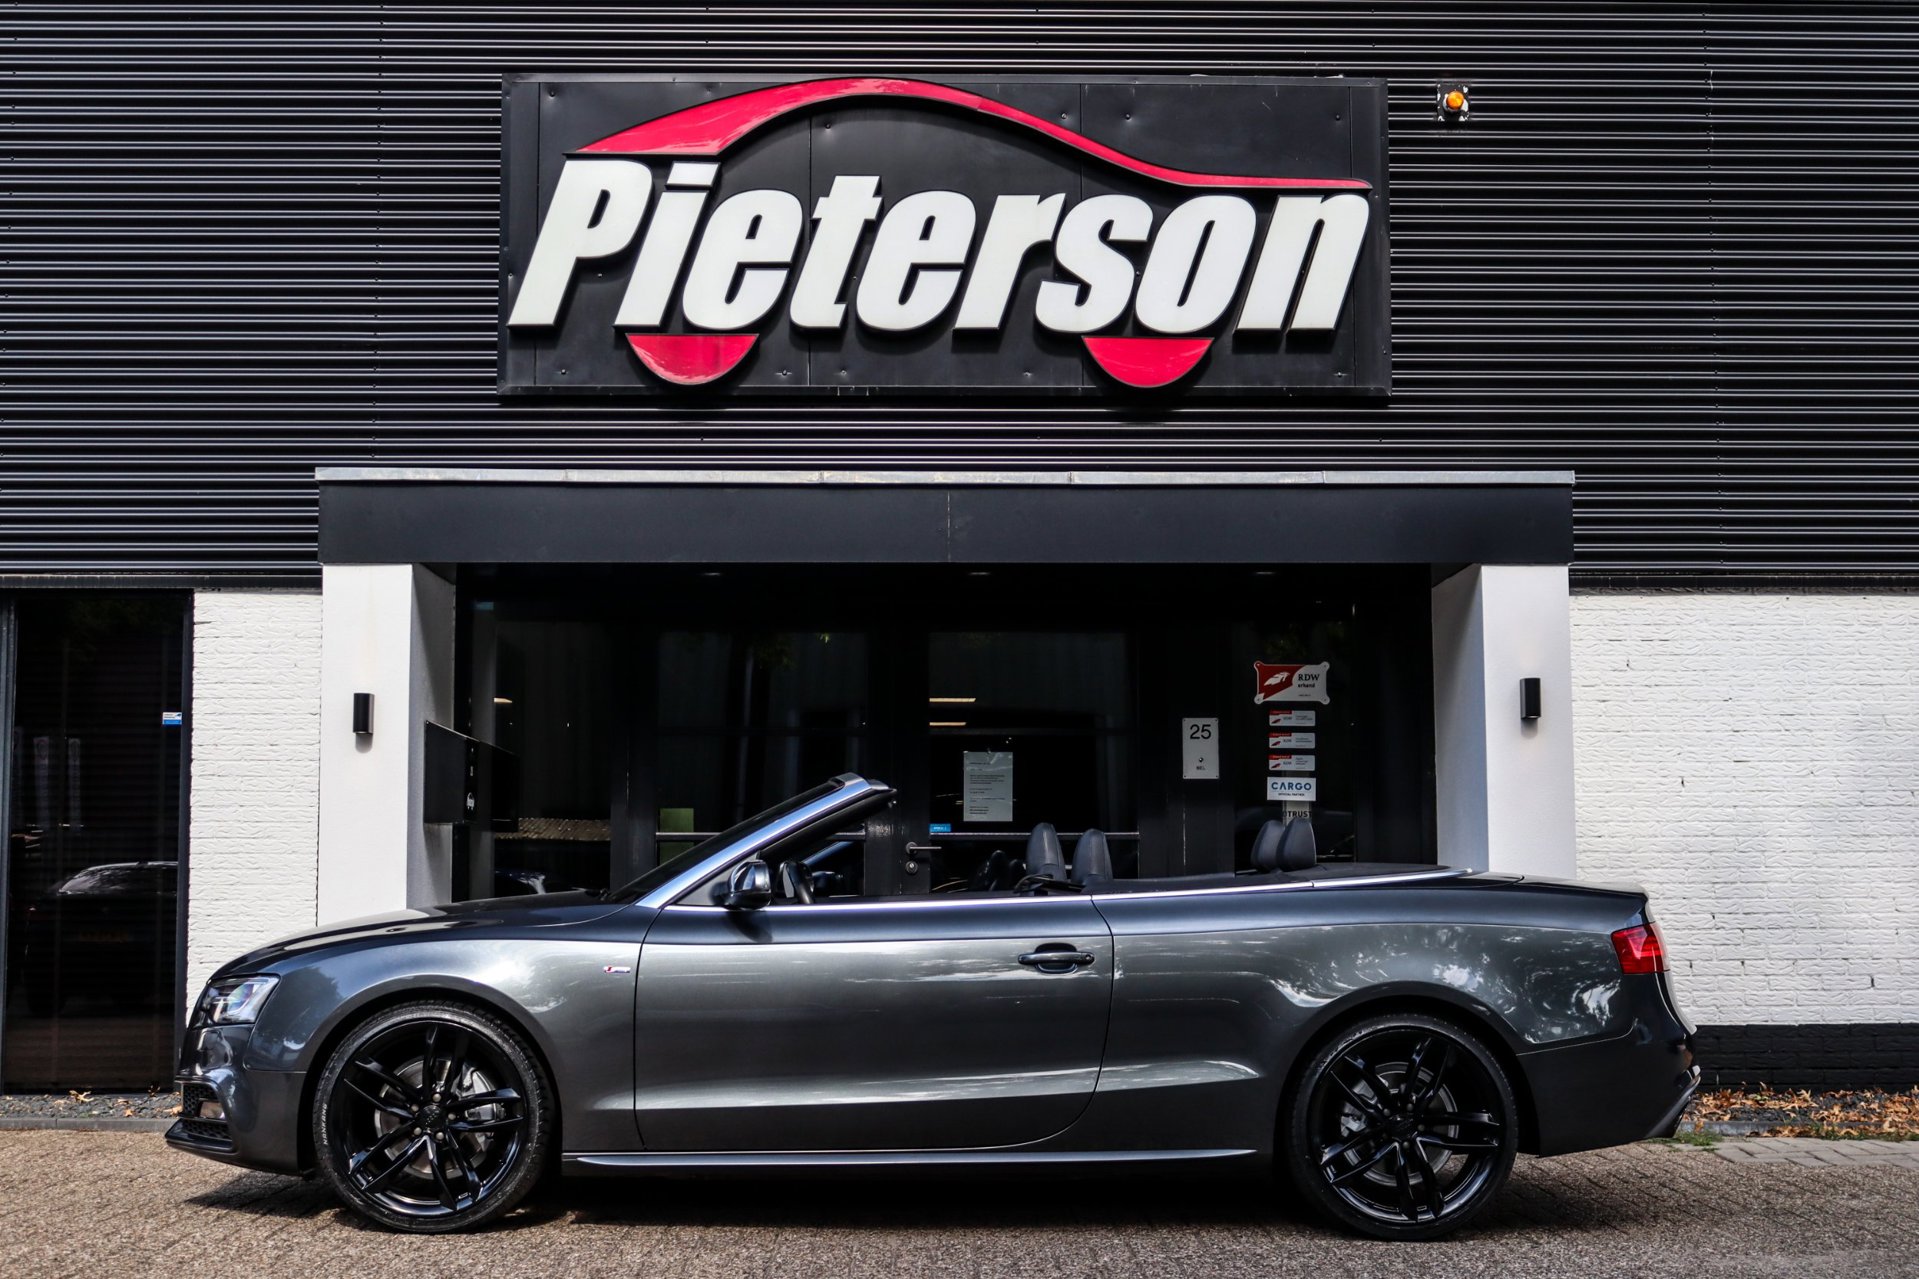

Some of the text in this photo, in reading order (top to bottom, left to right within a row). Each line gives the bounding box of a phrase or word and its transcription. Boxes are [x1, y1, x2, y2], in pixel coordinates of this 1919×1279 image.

[506, 157, 1371, 335] Pieterson
[1190, 724, 1212, 740] 25
[1271, 781, 1312, 791] CARGO
